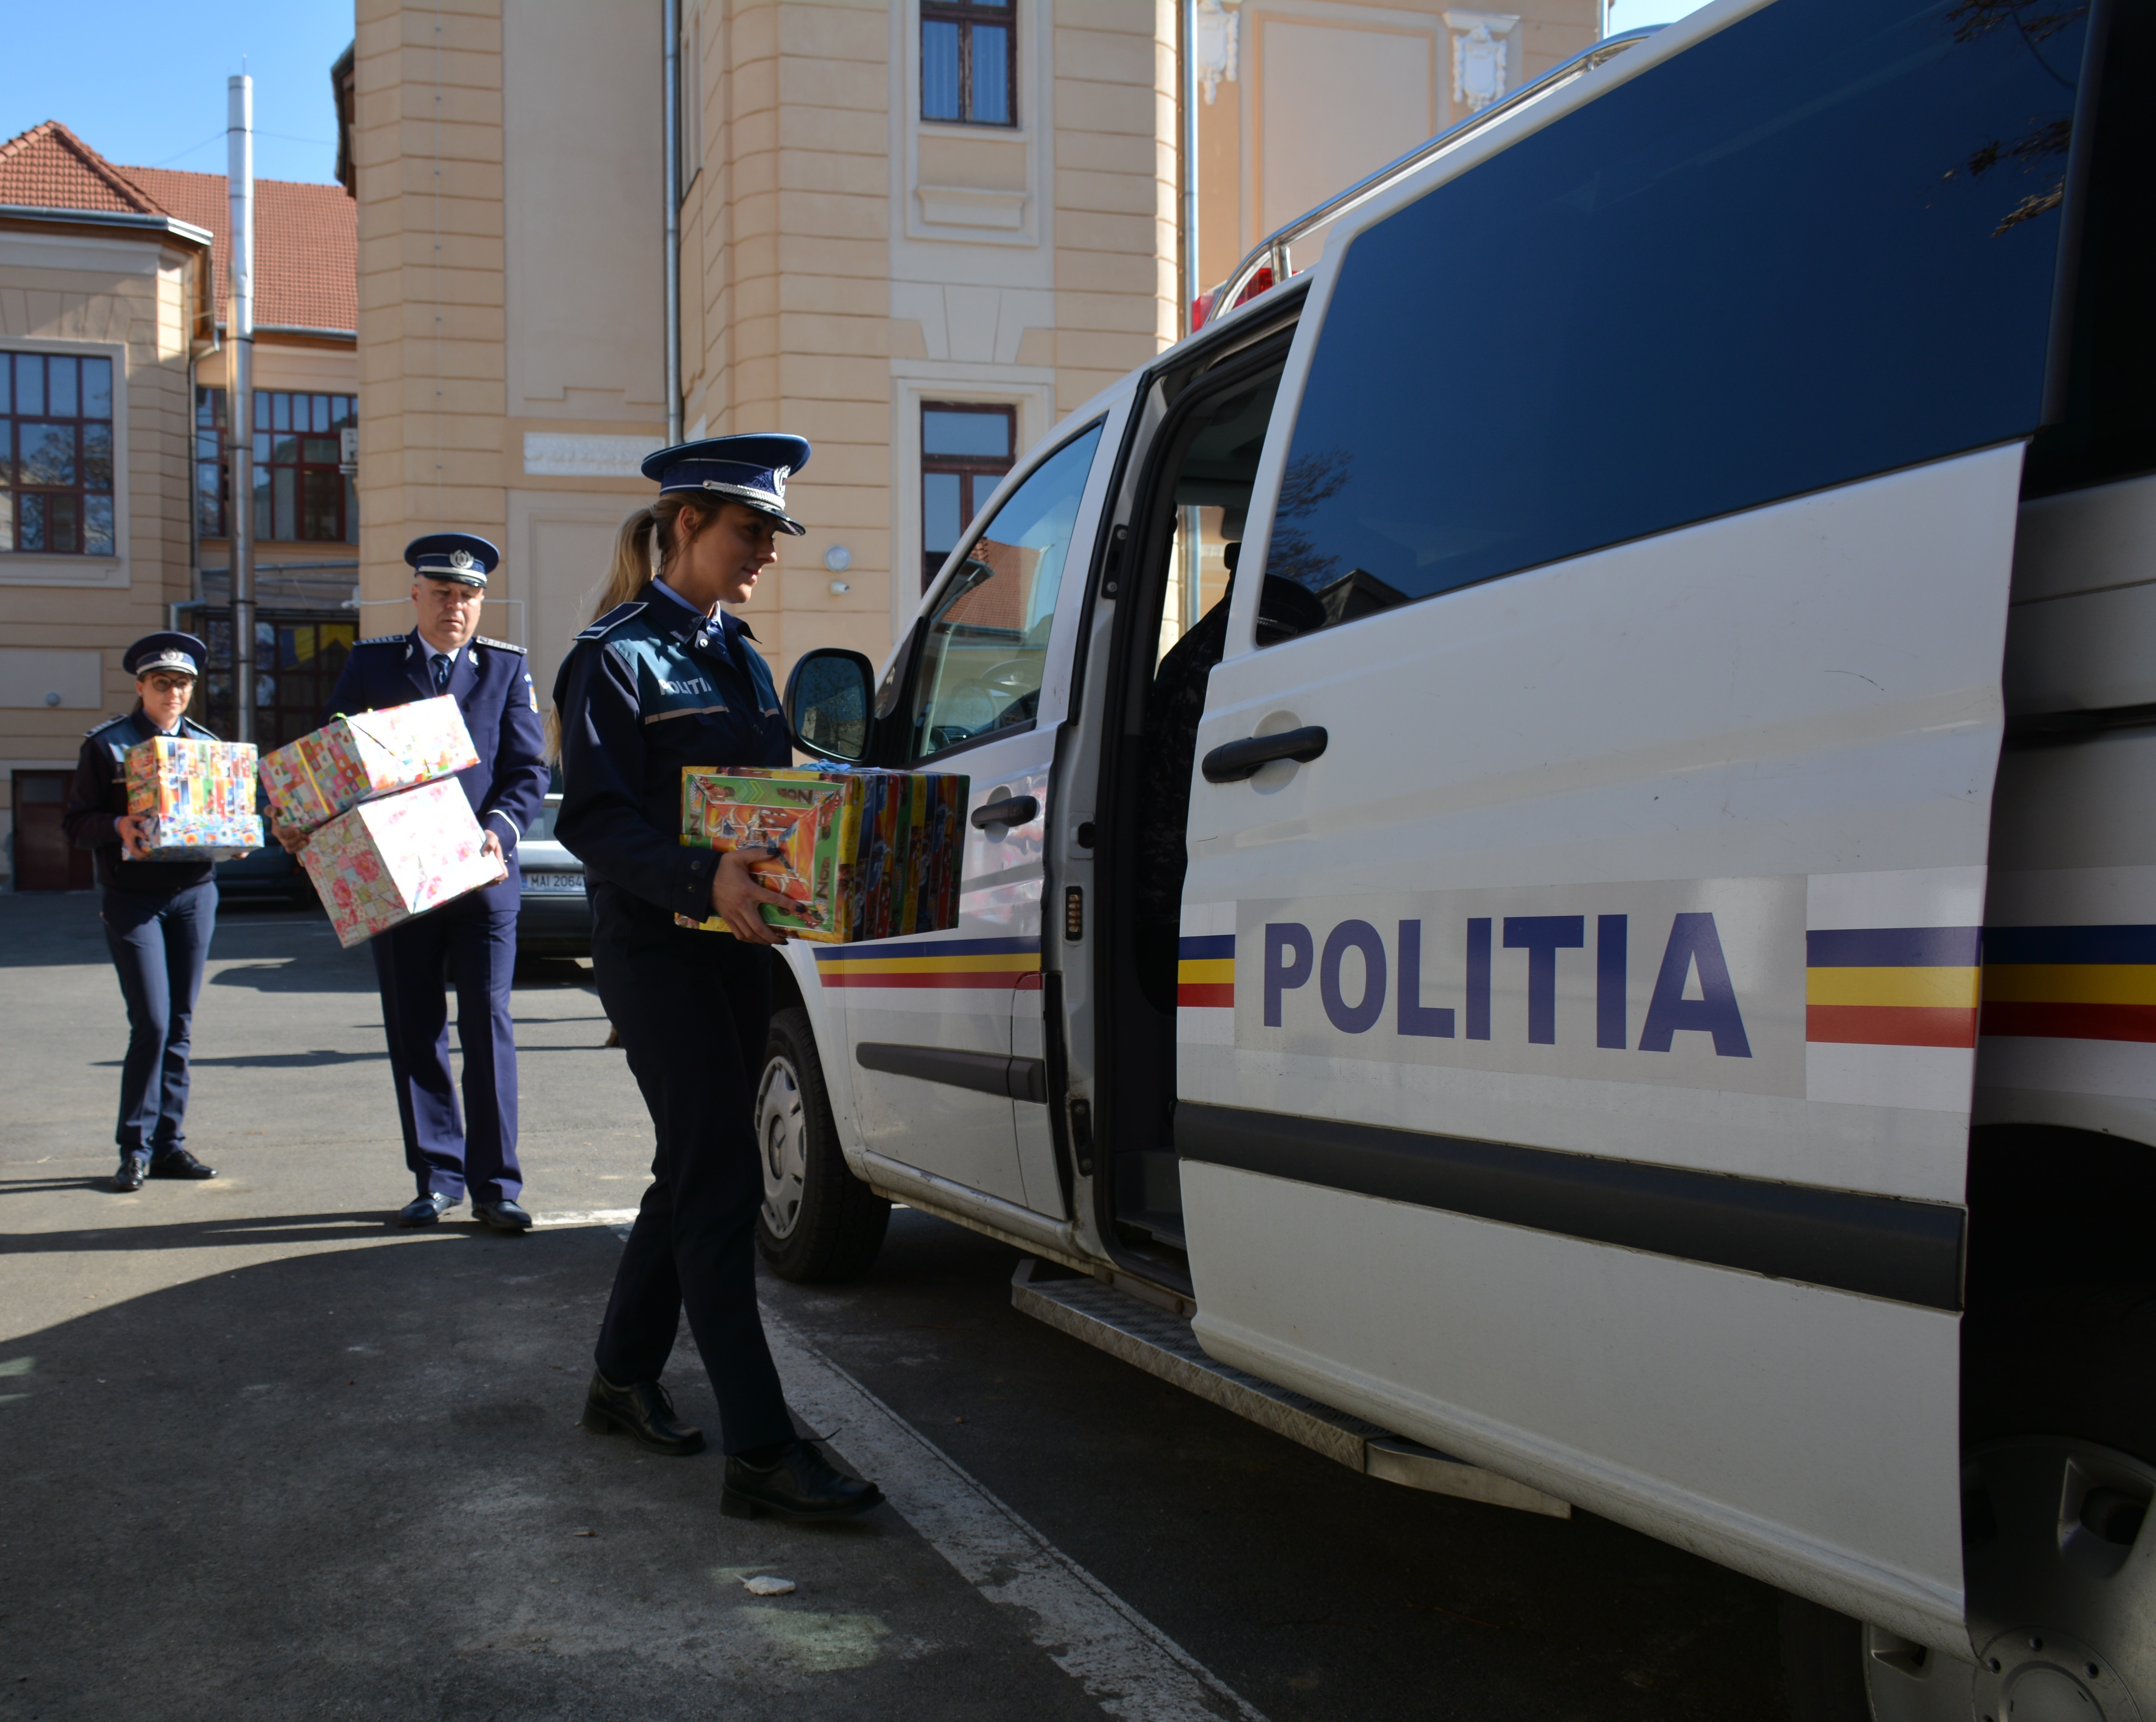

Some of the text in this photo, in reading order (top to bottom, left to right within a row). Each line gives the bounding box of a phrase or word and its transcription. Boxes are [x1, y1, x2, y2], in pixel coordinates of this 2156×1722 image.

[531, 876, 582, 887] MAI 2064
[1264, 912, 1753, 1058] POLITIA
